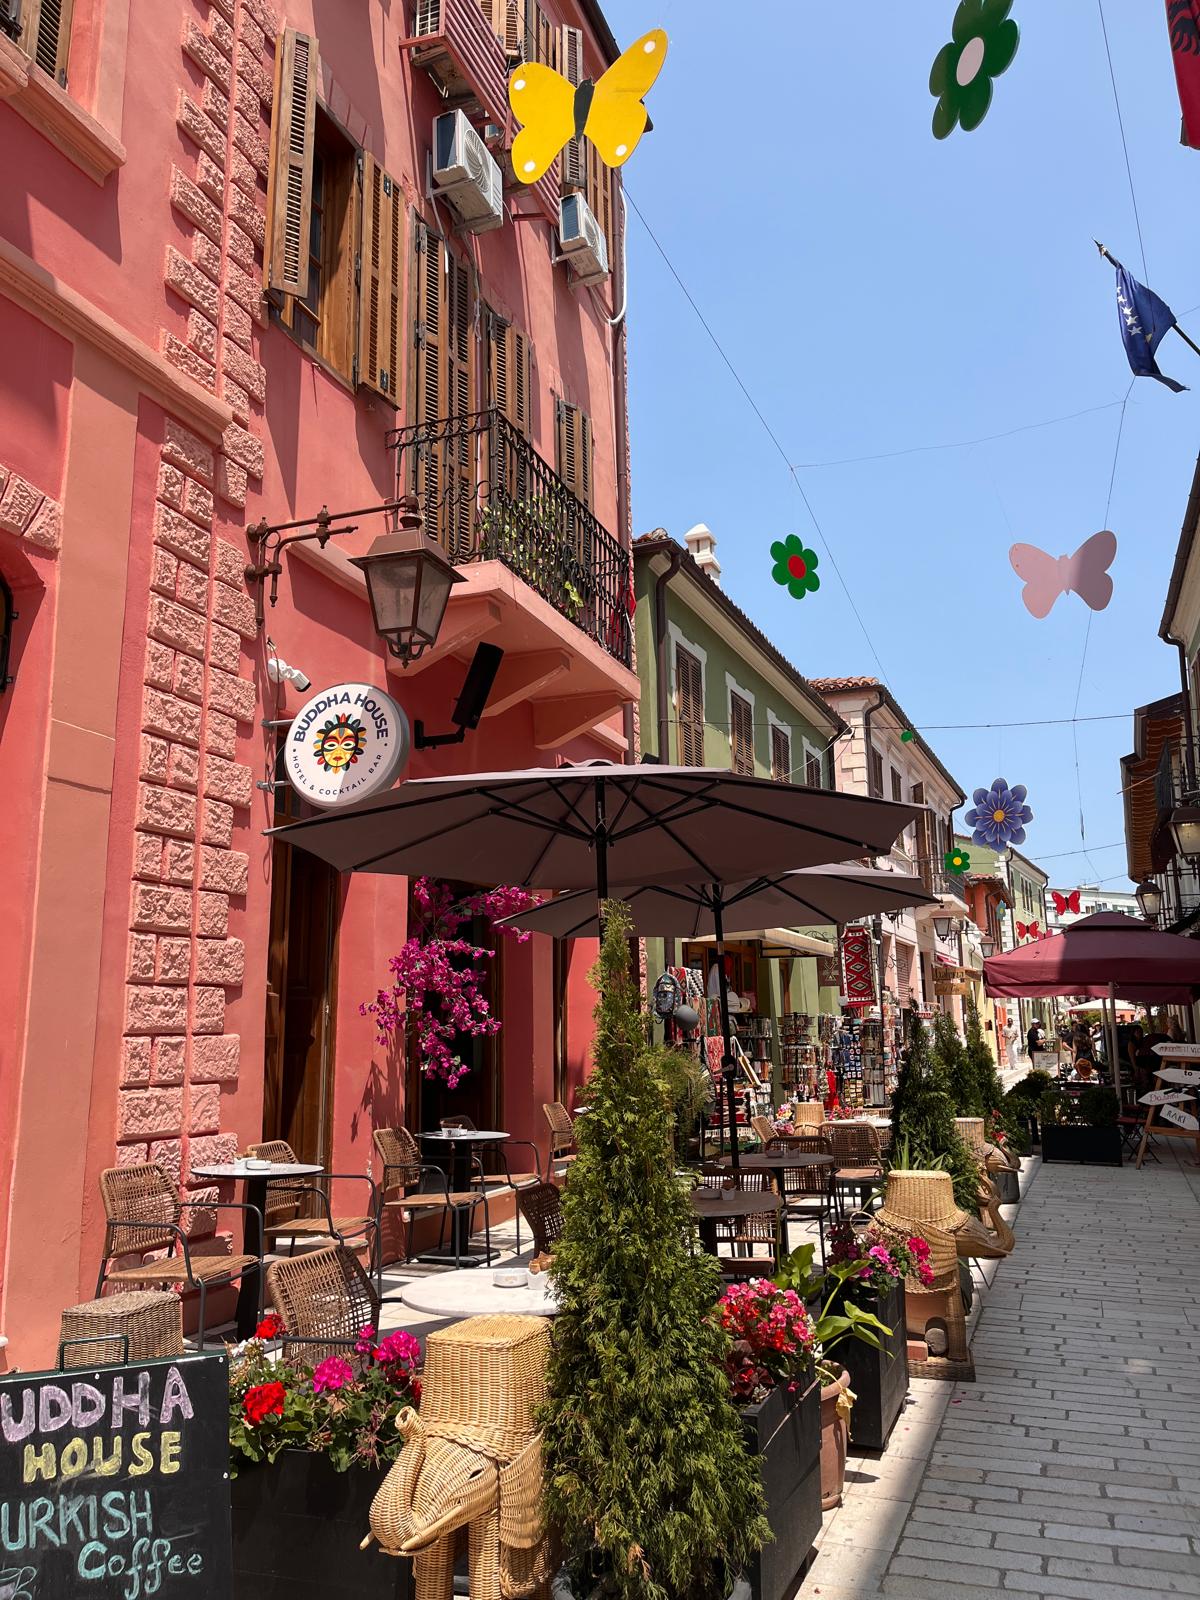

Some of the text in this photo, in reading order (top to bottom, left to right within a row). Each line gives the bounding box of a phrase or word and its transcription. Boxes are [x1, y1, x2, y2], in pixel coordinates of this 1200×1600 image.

[294, 692, 389, 742] BUDDHA HOUSE
[292, 755, 307, 785] HOTEL
[319, 777, 367, 795] COCKTAIL
[368, 754, 382, 774] BAR
[23, 1431, 182, 1483] HOUSE
[1, 1490, 153, 1551] URKISH
[78, 1538, 203, 1600] Coffee
